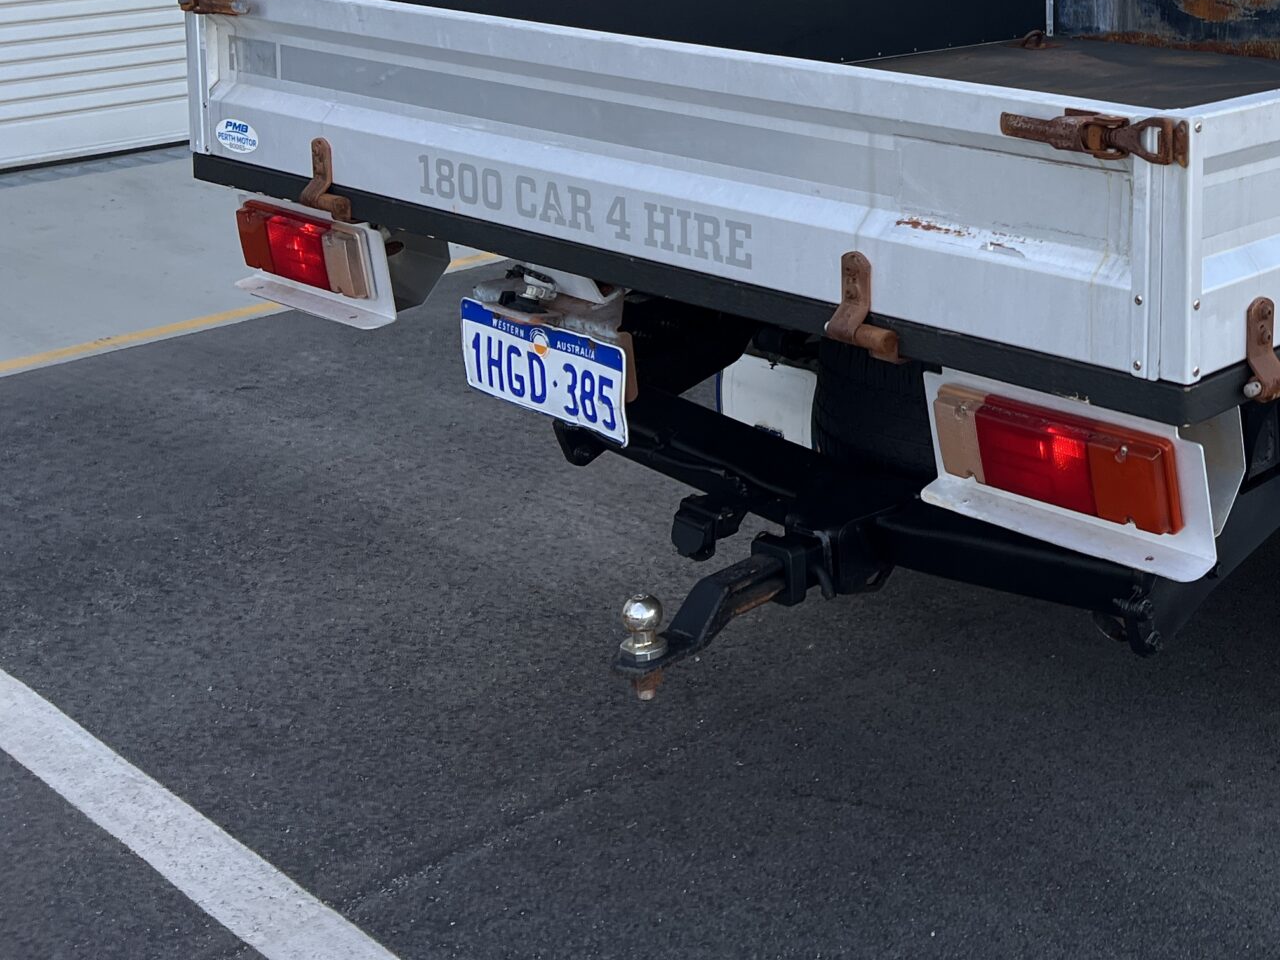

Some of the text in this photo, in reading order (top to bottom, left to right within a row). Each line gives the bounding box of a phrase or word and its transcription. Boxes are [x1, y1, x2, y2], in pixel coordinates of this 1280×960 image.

[218, 132, 257, 147] PERTH MOTOR
[225, 121, 249, 133] PMB
[417, 154, 753, 270] 1800 CAR 4 HIRE
[492, 318, 596, 360] WESTERN AUSTRALIA
